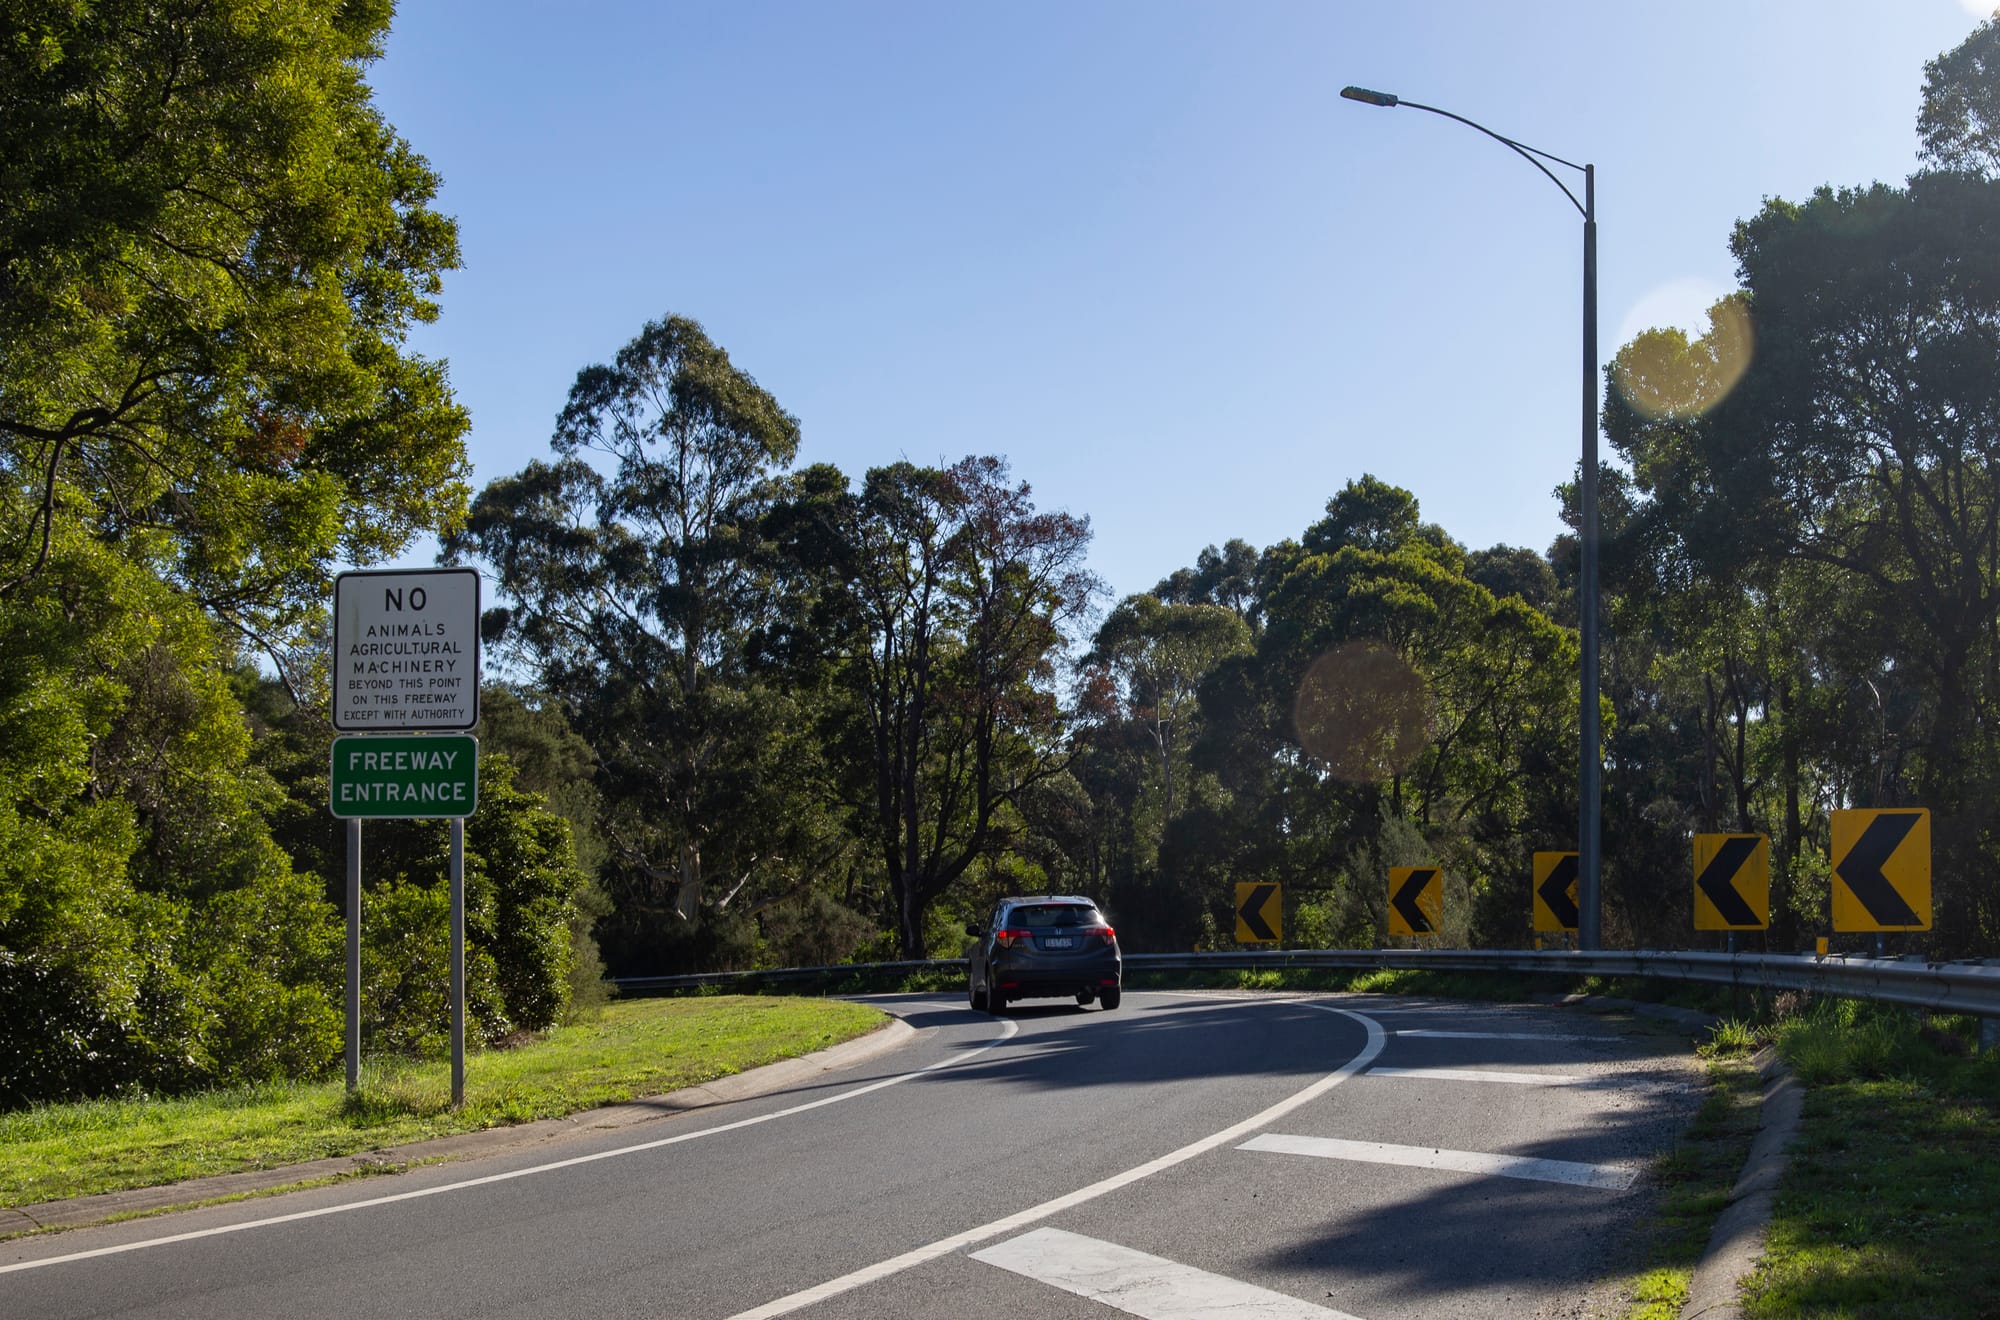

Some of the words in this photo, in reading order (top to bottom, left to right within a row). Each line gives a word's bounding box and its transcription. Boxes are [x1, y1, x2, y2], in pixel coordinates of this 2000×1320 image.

[385, 587, 426, 612] NO
[367, 624, 445, 637] ANIMALS
[350, 642, 461, 656] AGRICULTURAL
[354, 660, 456, 674] MACHINERY
[348, 680, 393, 689] BEYOND
[400, 679, 423, 688] THIS
[430, 678, 461, 688] POINT
[352, 695, 368, 704] ON
[375, 695, 398, 704] THIS
[405, 694, 457, 703] FREEWAY
[344, 710, 379, 720] EXCEPT
[384, 710, 406, 720] WITH
[411, 709, 464, 719] AUTHORITY
[350, 752, 458, 770] FREEWAY
[341, 782, 466, 801] ENTRANCE
